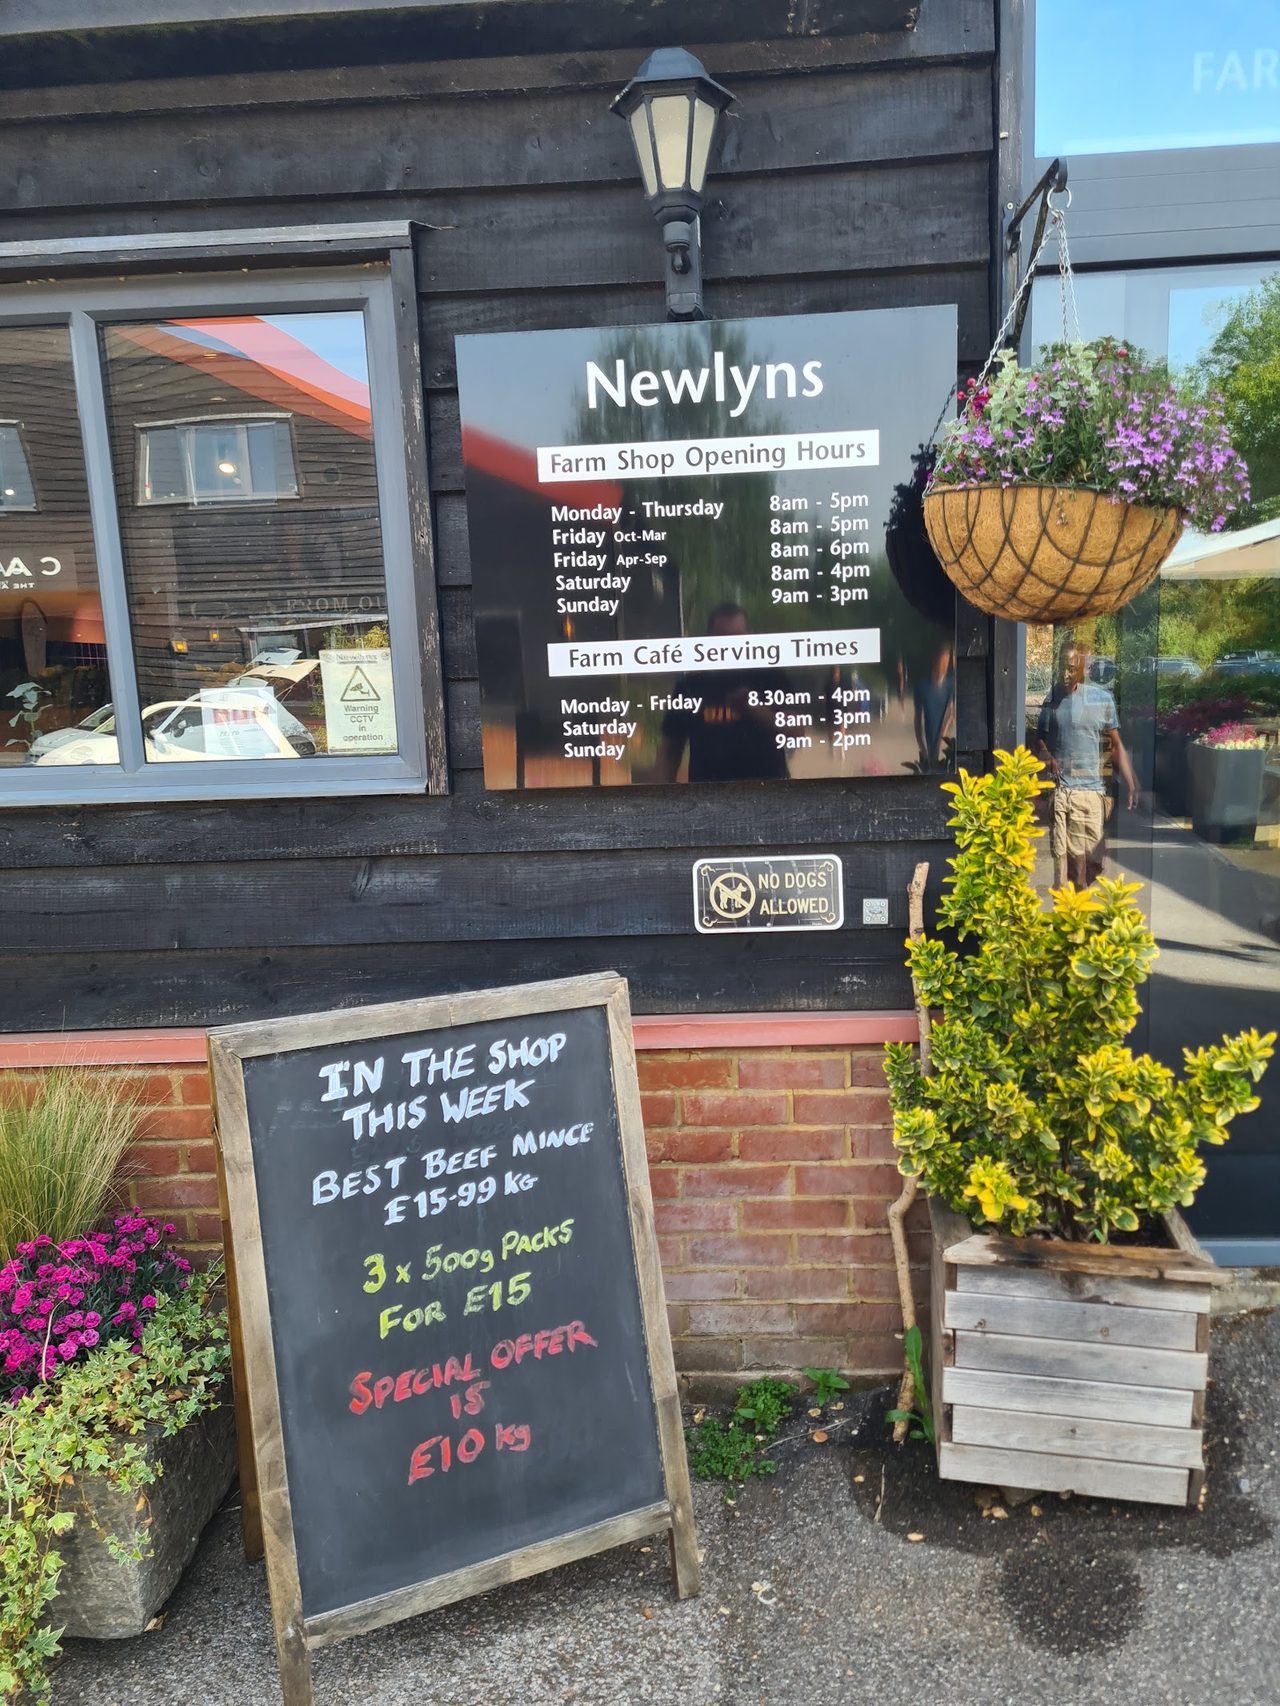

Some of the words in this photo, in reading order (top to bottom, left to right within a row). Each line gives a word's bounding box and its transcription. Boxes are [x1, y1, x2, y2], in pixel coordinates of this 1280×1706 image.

[584, 352, 826, 417] Newlyns
[552, 454, 605, 473] Farm
[618, 449, 674, 474] Shop
[686, 444, 786, 470] Opening
[798, 441, 865, 460] Hours
[552, 504, 622, 524] Monday
[642, 499, 723, 519] Thursday
[770, 495, 808, 511] 8am
[830, 492, 869, 510] 5pm
[553, 528, 605, 547] Friday
[614, 530, 666, 542] Oct-Mar
[771, 519, 808, 534] 8am
[830, 516, 869, 534] 5pm
[554, 551, 606, 570] Friday
[617, 553, 666, 568] Apr-Sep
[771, 542, 808, 557] 8am
[830, 539, 869, 557] 6pm
[556, 573, 631, 592] Saturday
[772, 566, 809, 581] 8am
[831, 563, 870, 582] 4pm
[557, 597, 619, 616] Sunday
[772, 589, 808, 603] 9am
[830, 586, 868, 604] 3pm
[570, 649, 622, 667] Farm
[634, 644, 682, 664] Café
[693, 641, 780, 665] Serving
[791, 638, 858, 657] Times
[344, 704, 379, 714] Warning
[561, 697, 629, 716] Monday
[651, 694, 702, 713] Friday
[748, 690, 810, 706] 8.30am
[832, 688, 870, 705] 4pm
[342, 733, 384, 742] operation
[563, 719, 636, 738] Saturday
[775, 712, 812, 727] 8am
[833, 709, 870, 727] 3pm
[565, 741, 625, 760] Sunday
[776, 734, 812, 748] 9am
[833, 732, 871, 749] 2pm
[758, 872, 780, 889] NO
[784, 871, 827, 888] DOGS
[759, 897, 829, 915] ALLOWED
[319, 1056, 384, 1102] IN
[401, 1044, 476, 1087] THE
[489, 1033, 567, 1075] SHOP
[342, 1095, 427, 1141] THIS
[440, 1079, 536, 1124] WEEK
[312, 1156, 406, 1206] BEST
[421, 1144, 497, 1181] BEEF
[513, 1122, 594, 1157] MINCE
[362, 1252, 387, 1294] 3
[501, 1218, 575, 1261] PACKS
[379, 1300, 446, 1339] FOR
[349, 1353, 481, 1415] SPECIAL
[491, 1320, 598, 1369] OFFER
[450, 1380, 491, 1420] IS
